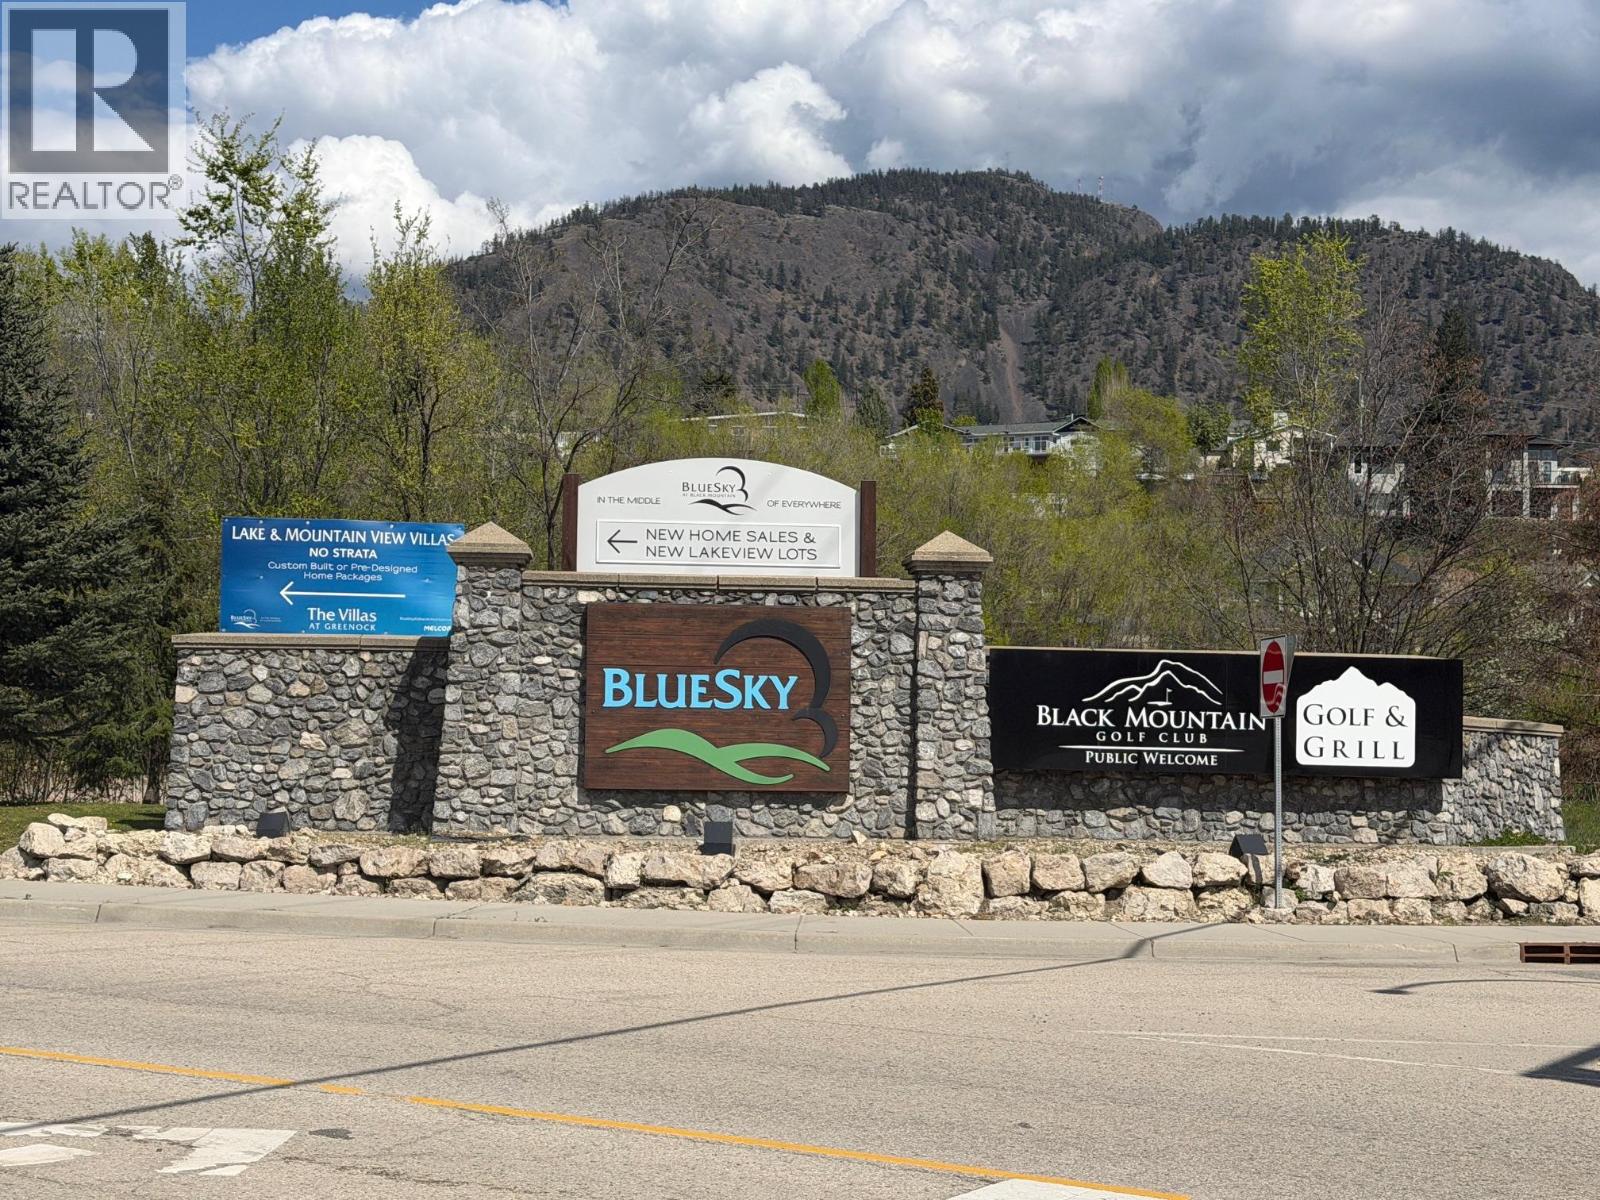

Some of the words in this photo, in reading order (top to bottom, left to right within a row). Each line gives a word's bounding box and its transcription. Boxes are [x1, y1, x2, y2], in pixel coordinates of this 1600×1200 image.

[682, 481, 736, 493] BLUESKY
[596, 496, 606, 504] IN
[608, 496, 625, 504] THE
[626, 496, 661, 505] MIDDLE
[766, 499, 780, 508] OF
[781, 500, 842, 509] EVERYWHERE
[232, 525, 266, 540] LAKE
[270, 528, 282, 541] &
[285, 527, 366, 544] MOUNTAIN
[370, 530, 406, 545] VIEW
[409, 531, 455, 546] VILLAS
[646, 528, 684, 541] NEW
[689, 529, 741, 542] HOME
[746, 530, 798, 543] SALES
[803, 532, 816, 543] &
[309, 547, 329, 558] NO
[332, 548, 378, 559] STRATA
[646, 545, 684, 557] NEW
[689, 546, 773, 560] LAKEVIEW
[778, 548, 817, 560] LOTS
[267, 561, 308, 570] Custom
[310, 562, 334, 571] Built
[351, 563, 418, 575] Pre-Designed
[303, 571, 333, 580] Home
[335, 572, 383, 583] Packages
[307, 607, 336, 621] The
[338, 608, 377, 622] Villas
[309, 622, 320, 630] AT
[324, 622, 376, 631] GREENOCK
[602, 667, 799, 710] BLUESKY
[1036, 704, 1116, 727] BLACK
[1124, 706, 1266, 731] MOUNTAIN
[1303, 703, 1375, 726] GOLF
[1385, 705, 1409, 728] &
[1095, 731, 1146, 742] GOLF
[1158, 732, 1208, 743] CLUB
[1303, 735, 1405, 760] GRILL
[1085, 750, 1139, 764] PUBLIC
[1143, 752, 1219, 766] WELCOME
